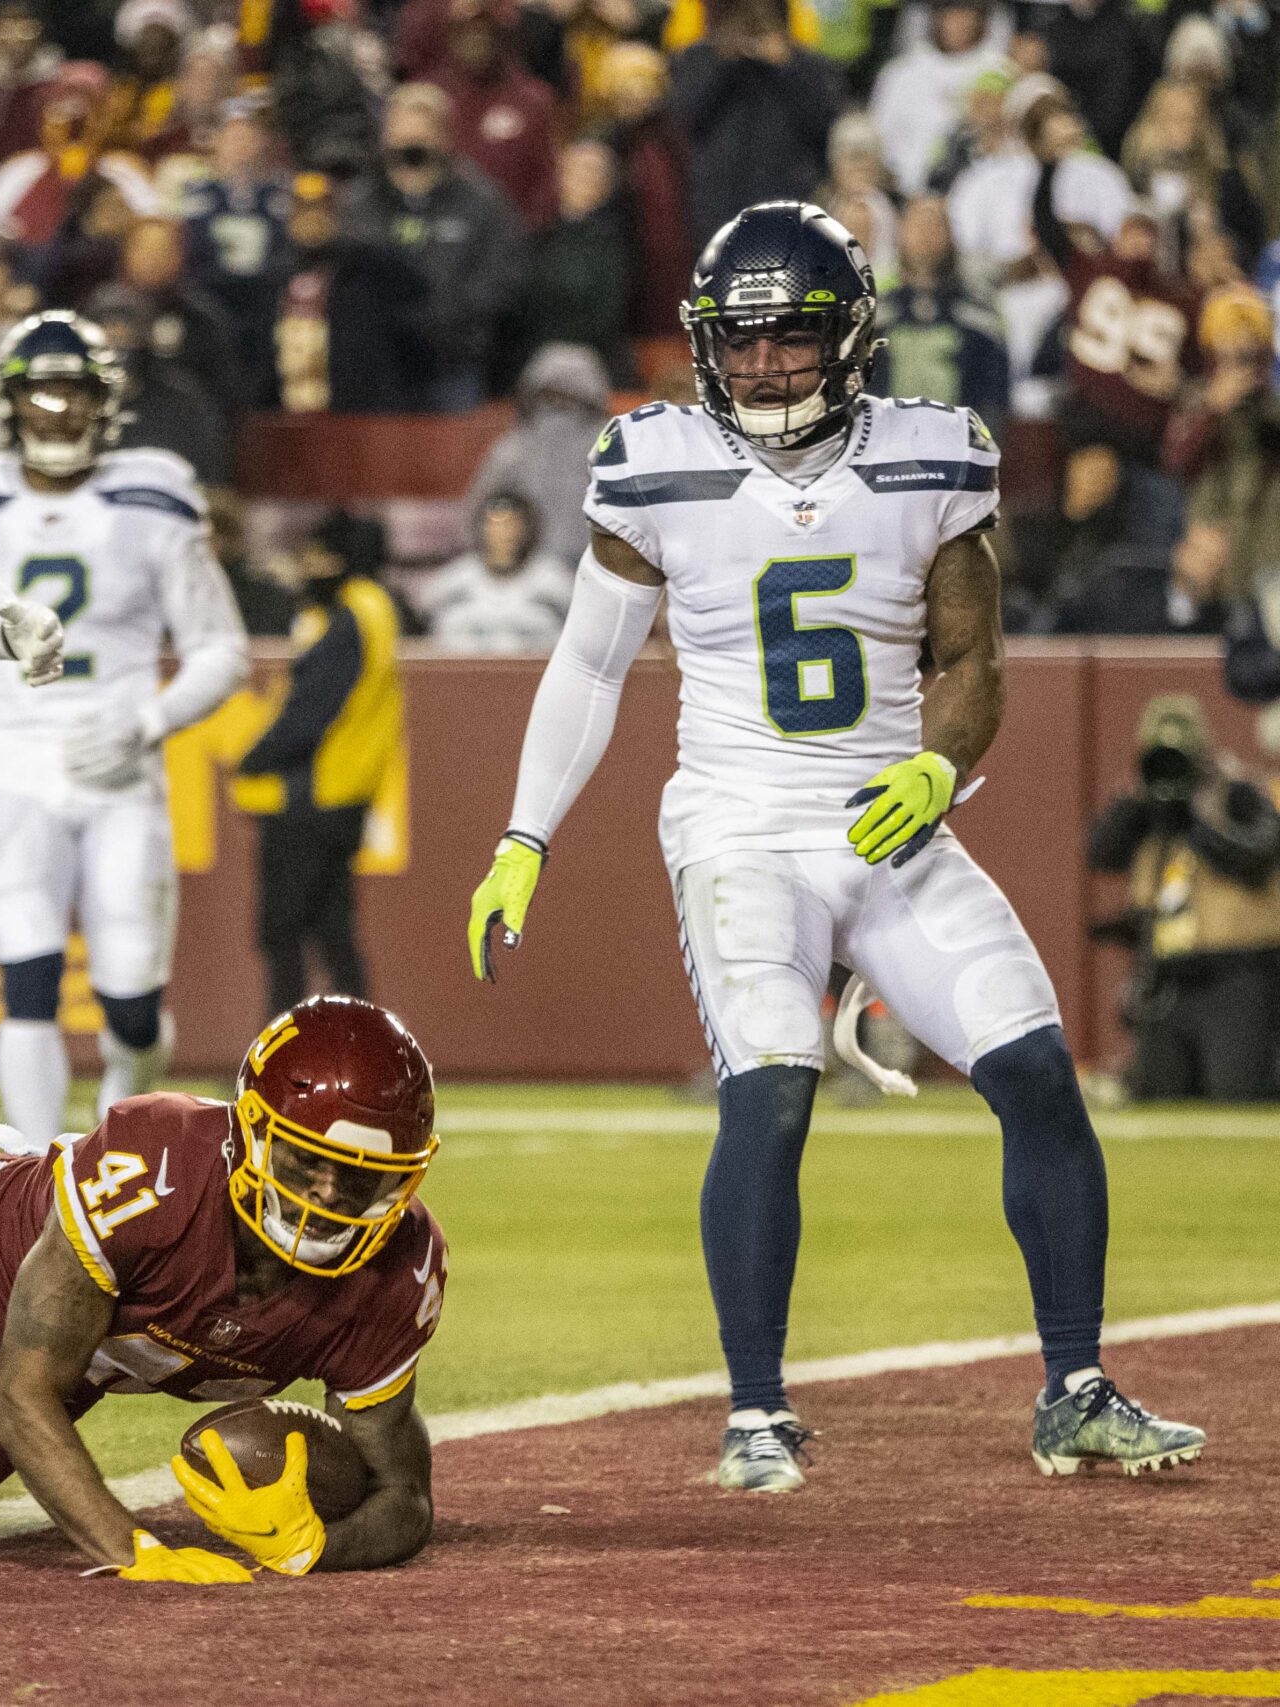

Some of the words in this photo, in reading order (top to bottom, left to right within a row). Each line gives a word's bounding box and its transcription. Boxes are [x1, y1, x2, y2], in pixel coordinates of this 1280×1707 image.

[17, 554, 96, 679] 2
[752, 553, 870, 738] 6
[78, 1150, 160, 1240] 41
